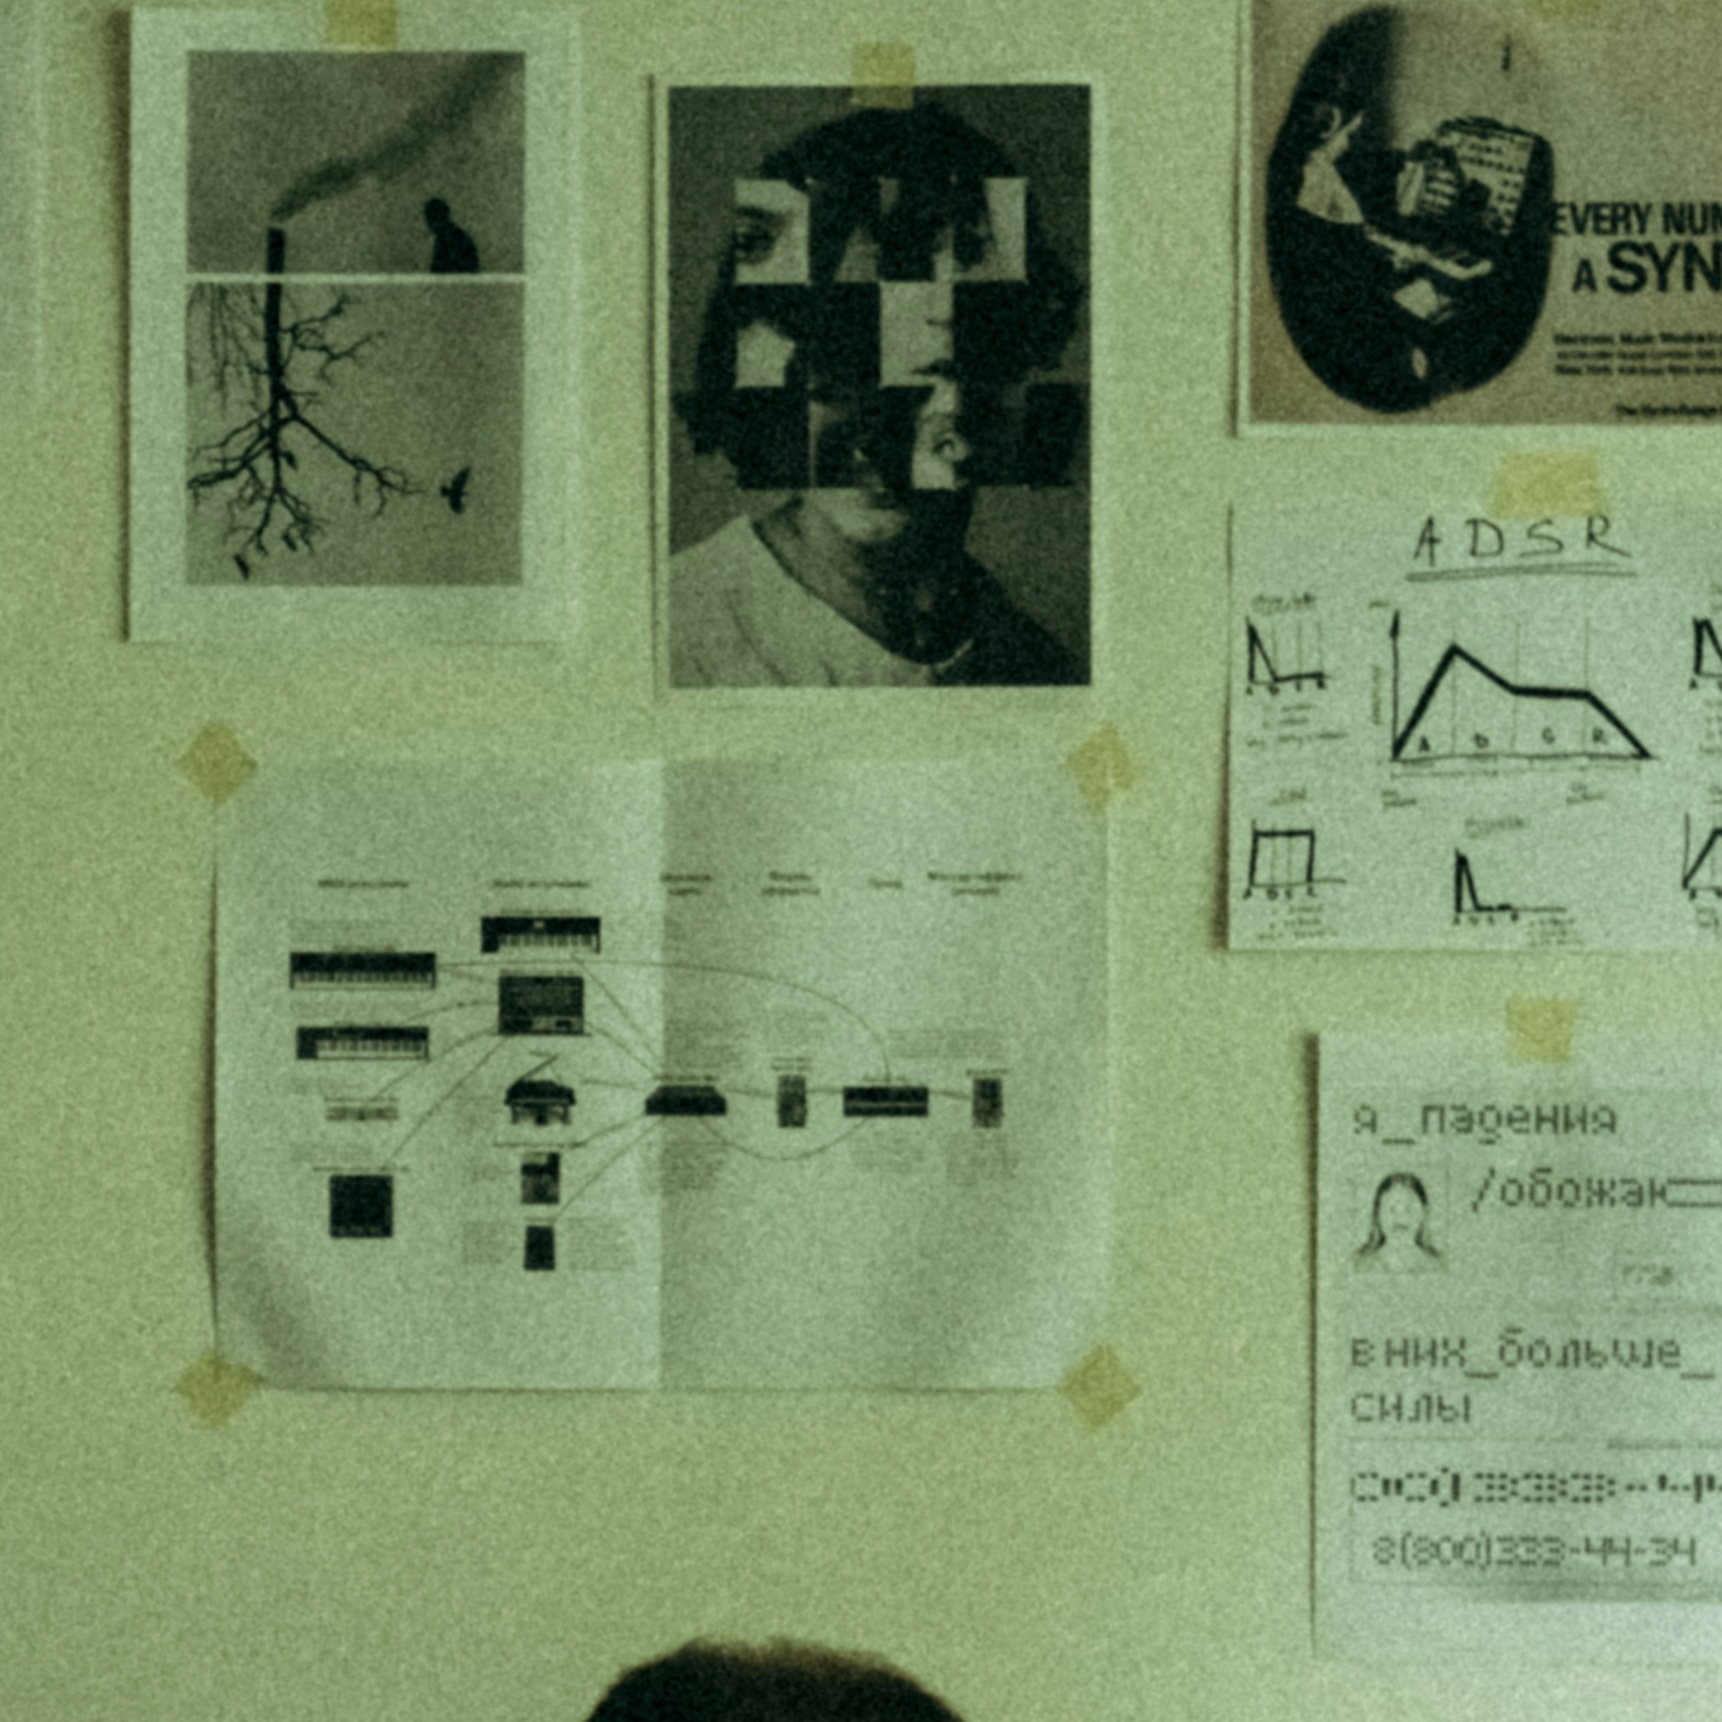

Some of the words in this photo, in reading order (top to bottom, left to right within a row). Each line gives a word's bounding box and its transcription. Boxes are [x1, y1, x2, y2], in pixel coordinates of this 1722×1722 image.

[1551, 201, 1653, 237] EVERY
[1571, 257, 1599, 293] A
[1372, 1530, 1697, 1571] 8(800)333-44-34
